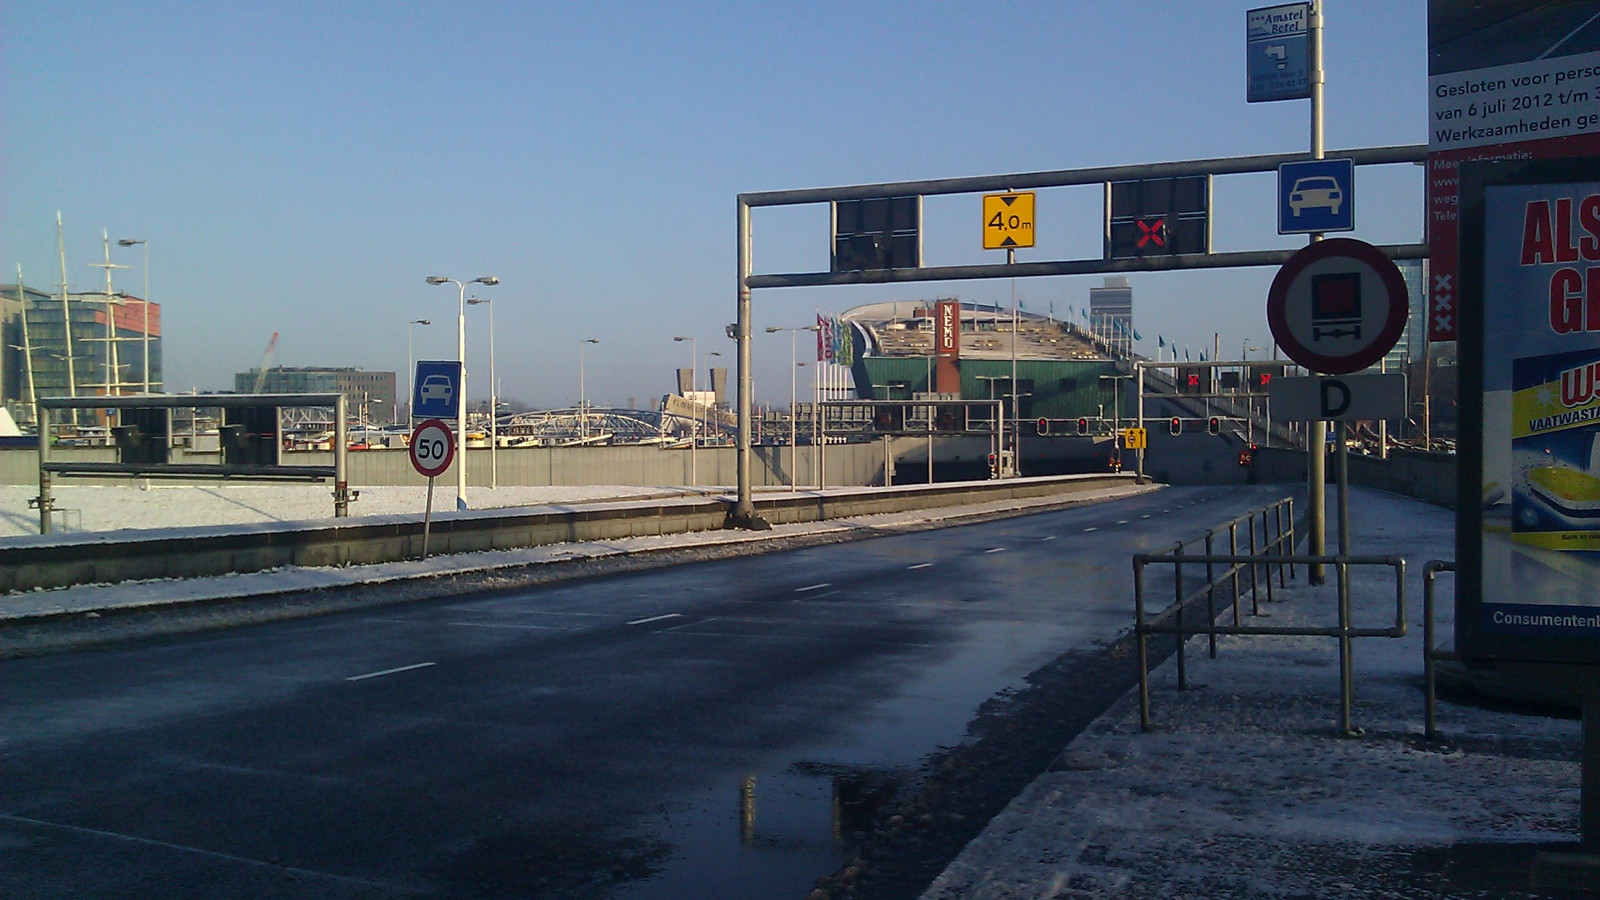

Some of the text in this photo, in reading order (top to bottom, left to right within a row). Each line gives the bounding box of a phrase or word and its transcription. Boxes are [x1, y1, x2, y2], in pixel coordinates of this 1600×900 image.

[1265, 10, 1303, 24] Amstel
[1271, 21, 1299, 34] Botel
[1436, 80, 1506, 98] Gesloten
[1511, 73, 1550, 88] voor
[1436, 107, 1462, 121] van
[1468, 103, 1477, 117] 6
[1482, 98, 1506, 119] juli
[1512, 93, 1553, 111] 2012
[1558, 89, 1588, 105] t/m
[1436, 116, 1570, 143] Werkzaamheden
[1520, 193, 1600, 266] ALS
[943, 304, 953, 349] NEMO
[1320, 380, 1351, 417] D
[418, 439, 444, 460] 50
